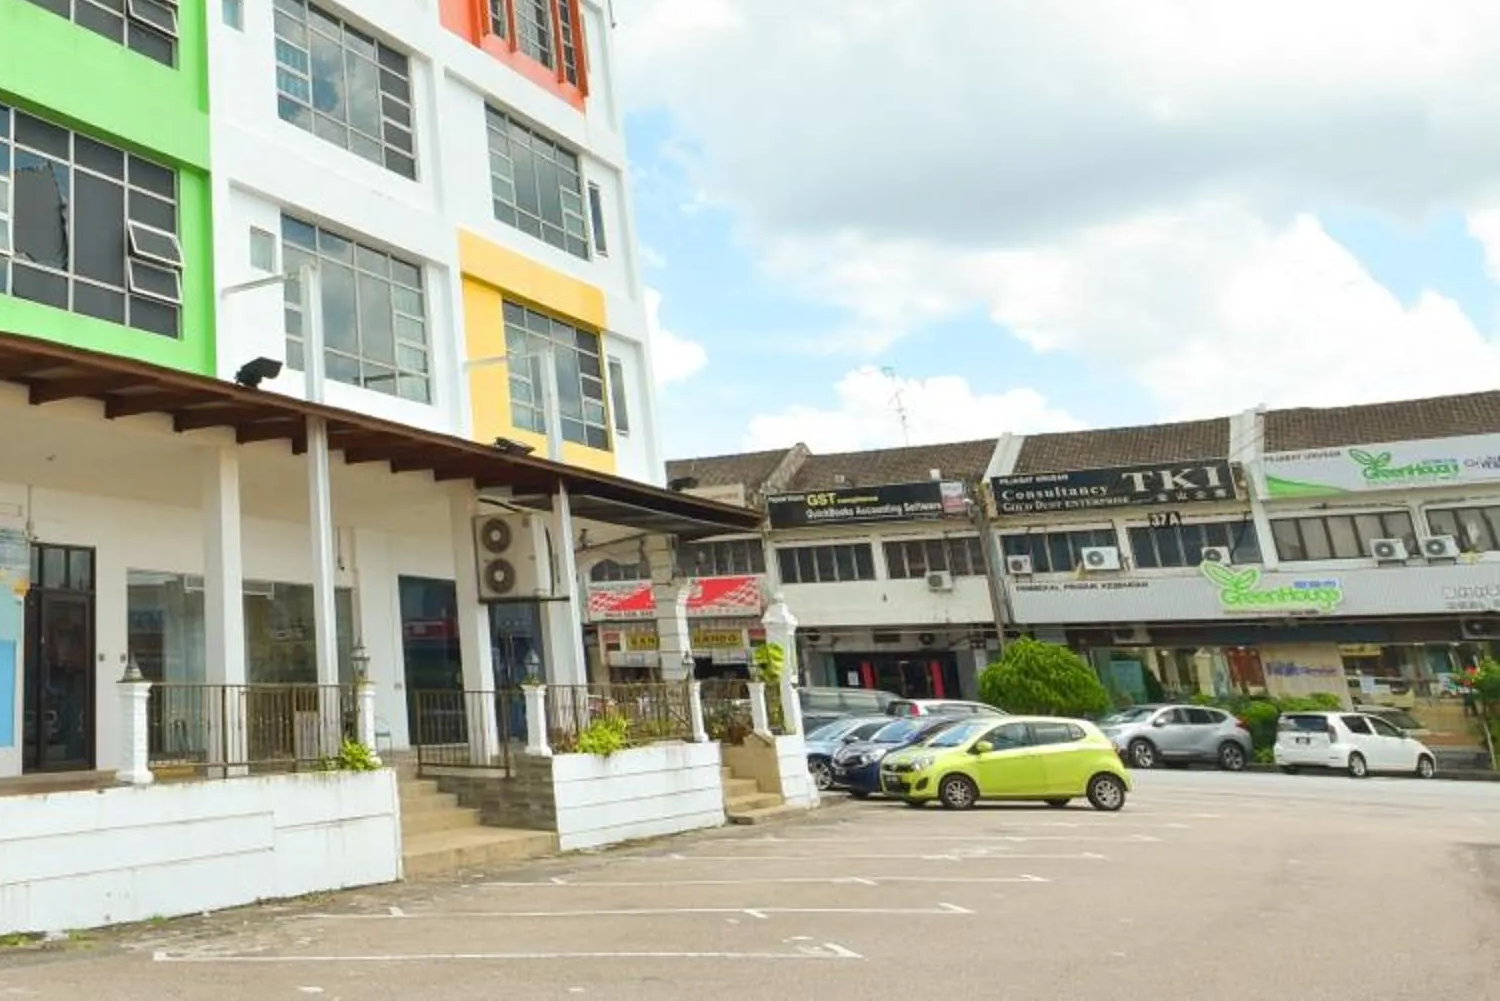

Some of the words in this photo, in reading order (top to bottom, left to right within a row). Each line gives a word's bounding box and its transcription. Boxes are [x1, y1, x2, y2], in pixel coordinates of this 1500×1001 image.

[1121, 466, 1222, 493] TKI
[806, 492, 837, 507] GST
[1001, 484, 1109, 501] Consultancy
